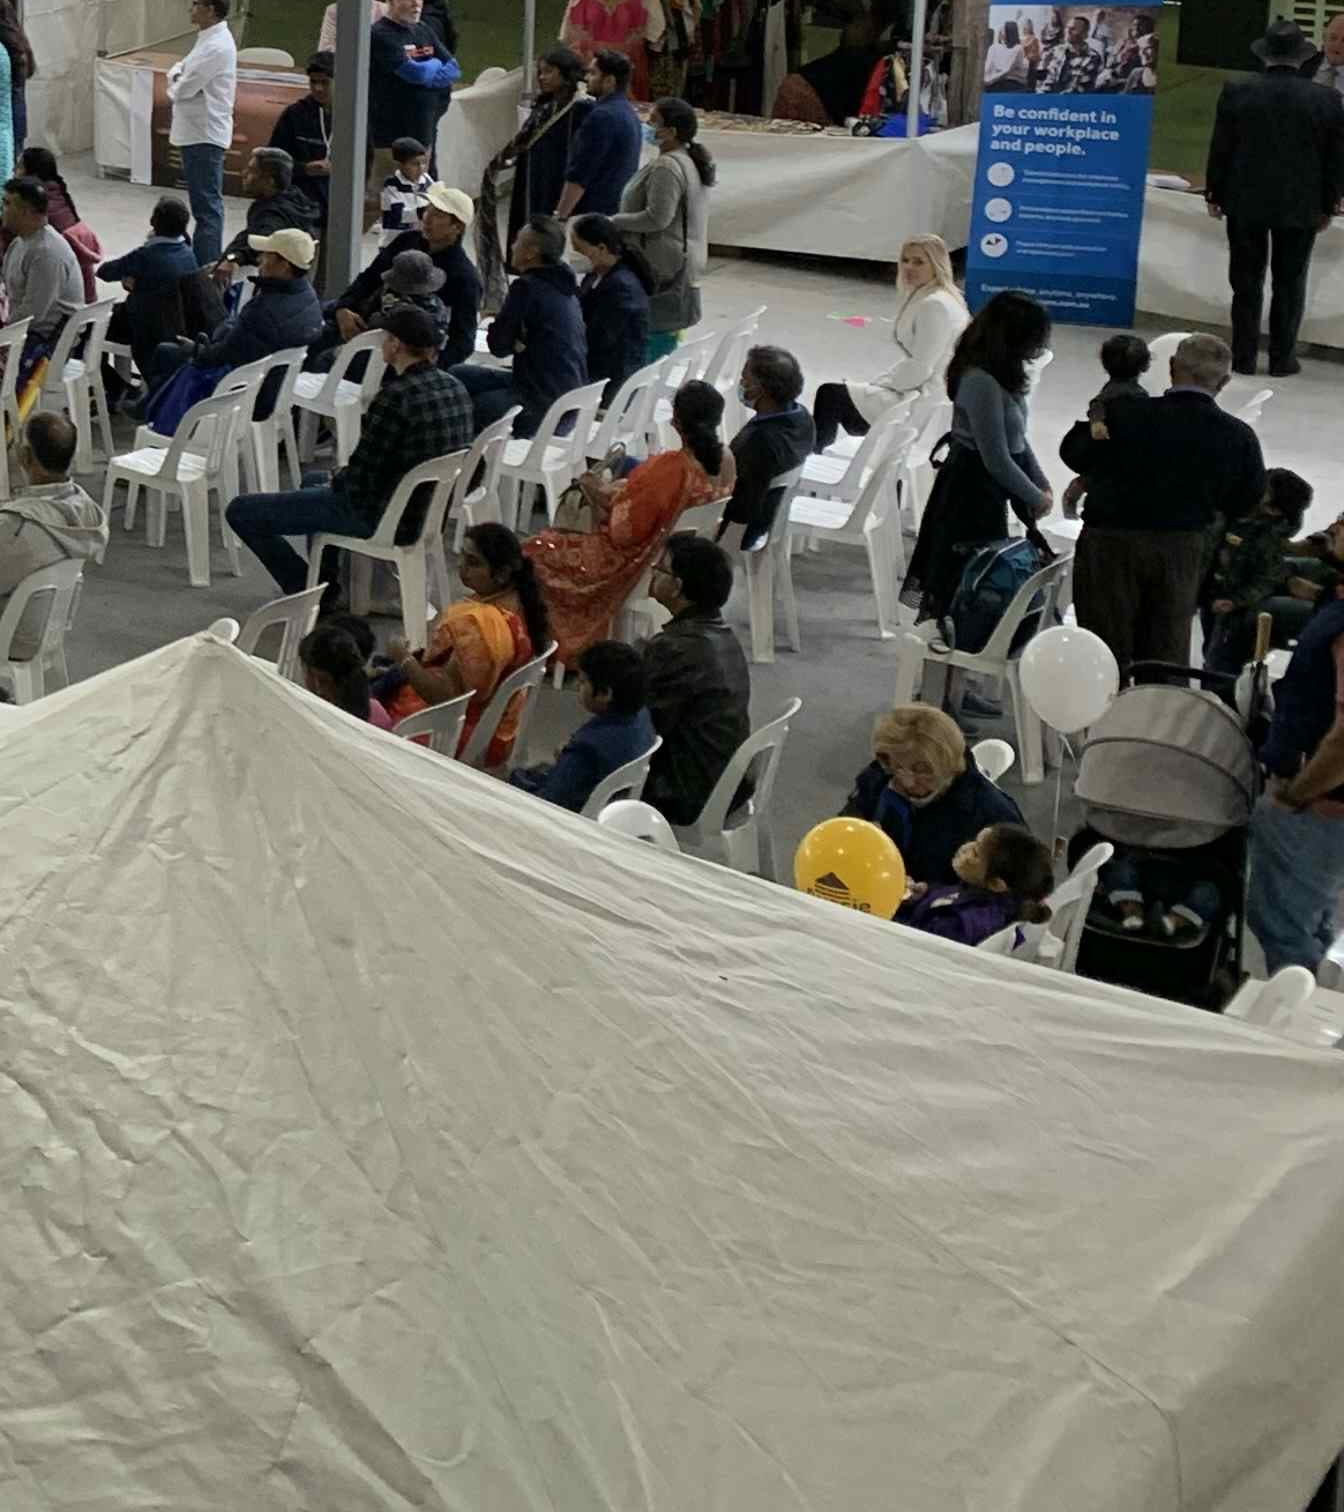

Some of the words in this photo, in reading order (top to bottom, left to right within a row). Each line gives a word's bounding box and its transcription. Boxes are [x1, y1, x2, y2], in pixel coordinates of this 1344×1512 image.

[993, 104, 1015, 118] Be
[1018, 105, 1098, 123] confident
[1101, 110, 1117, 124] in
[991, 123, 1030, 137] your
[1034, 124, 1120, 142] workplace
[990, 138, 1022, 152] and
[1024, 142, 1087, 157] people.
